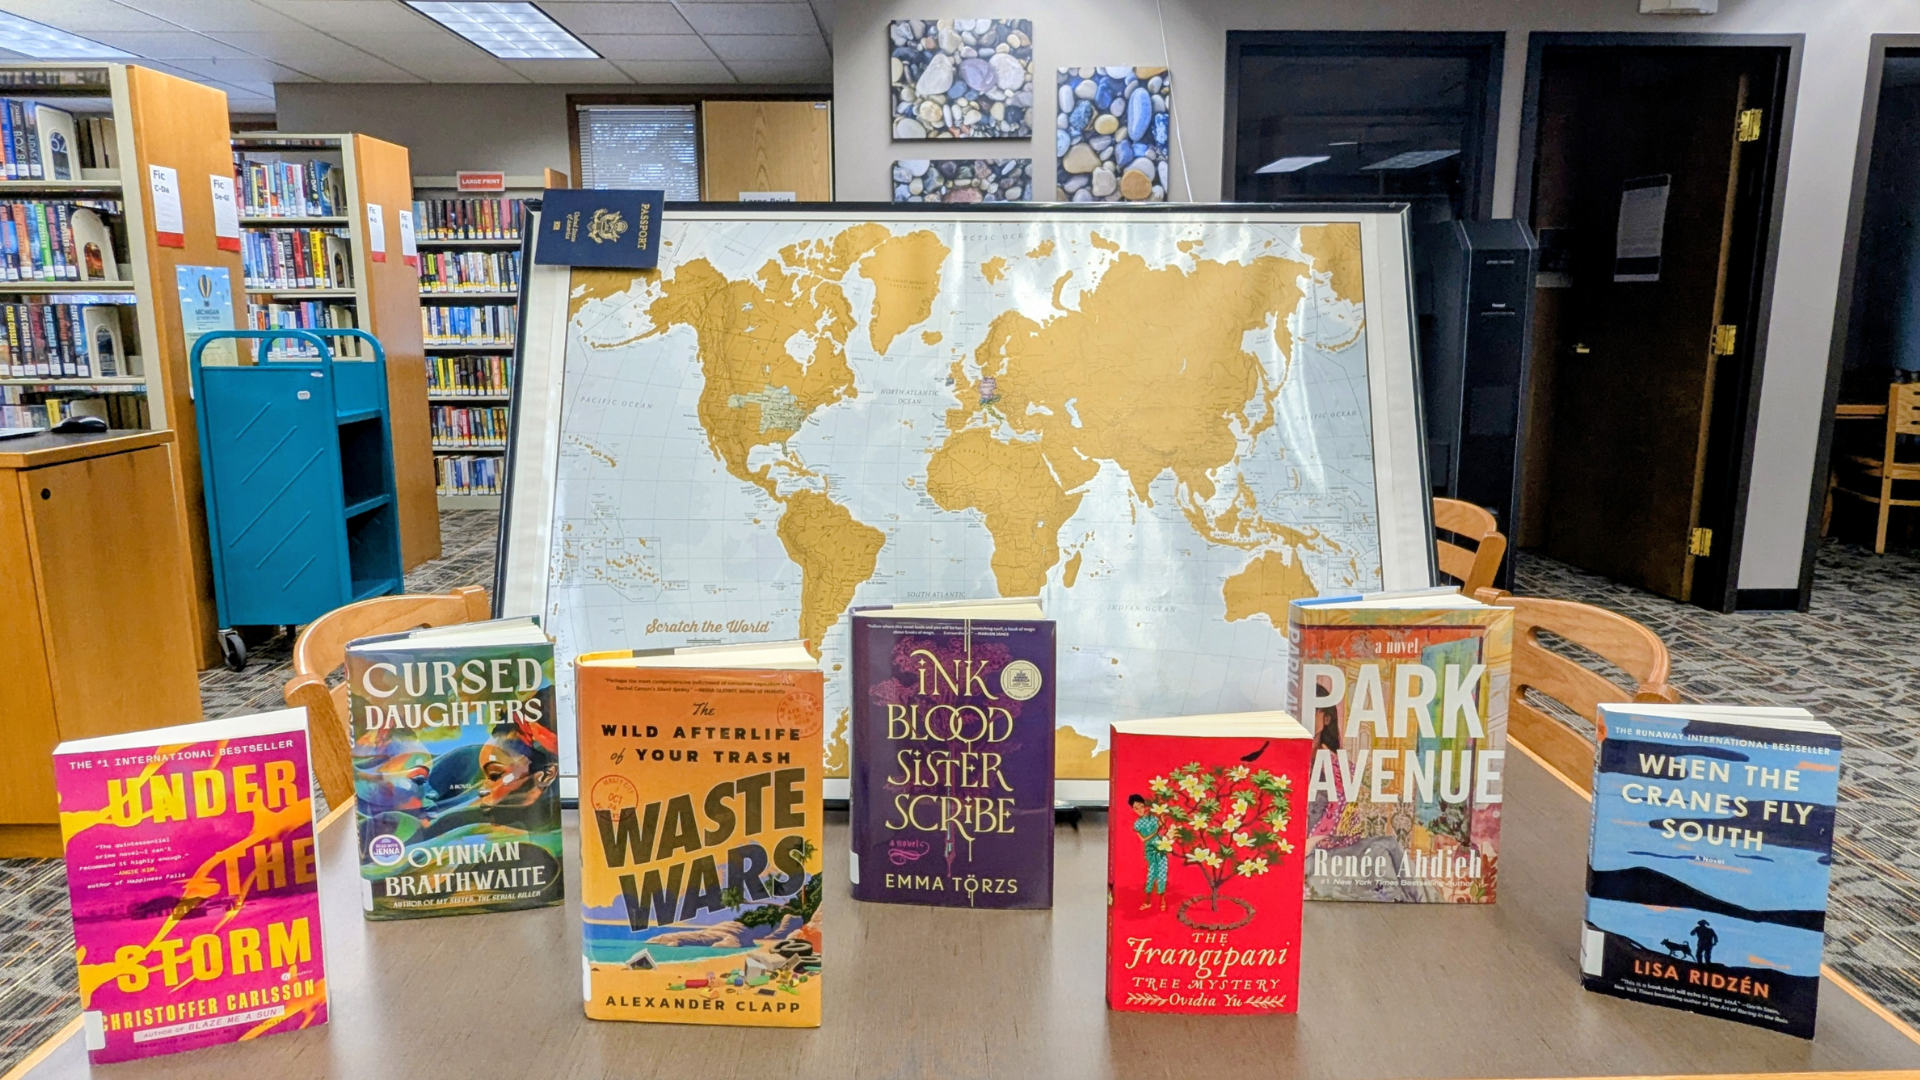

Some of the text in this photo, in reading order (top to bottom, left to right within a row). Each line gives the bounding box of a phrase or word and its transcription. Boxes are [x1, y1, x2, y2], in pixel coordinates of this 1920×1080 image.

[27, 133, 37, 158] JUDAS
[153, 169, 165, 180] Fic
[213, 179, 224, 189] Fic
[154, 184, 170, 193] C-Da
[57, 205, 67, 221] CLIVE
[637, 203, 650, 250] PASSPORT
[6, 305, 15, 322] CLIVE
[20, 305, 29, 322] CLIVE
[70, 304, 80, 321] CLIVE
[581, 396, 653, 409] PACIFIC OCEAN
[1330, 410, 1357, 418] OCEAN
[1145, 605, 1176, 613] OCEAN
[645, 618, 770, 636] Scratch the World
[1374, 638, 1419, 654] a novel
[1287, 627, 1300, 688] PARK
[362, 657, 543, 699] CURSED
[693, 701, 716, 716] The
[1302, 664, 1487, 738] PARK
[364, 698, 543, 731] DAUGHTERS
[887, 704, 1014, 743] BLOOD
[601, 724, 800, 741] WILD AFTERLIFE
[1615, 726, 1831, 756] THE RUNAWAY INTERNATIONAL BESTSELLER
[69, 760, 93, 771] THE
[114, 749, 214, 767] INTERNATIONAL
[219, 739, 294, 756] BESTSELLER
[610, 747, 790, 766] of YOUR TRASH
[887, 749, 1014, 792] SISTER
[1308, 750, 1506, 803] AVENUE
[1638, 753, 1800, 792] WHEN THE
[107, 760, 299, 828] UNDER
[608, 792, 623, 804] OCT
[1621, 783, 1814, 825] CRANES FLY
[594, 767, 807, 869] WASTE
[885, 793, 1016, 842] SCRIBE
[114, 837, 170, 849] quintessential
[897, 839, 919, 847] novel
[1661, 818, 1763, 851] SOUTH
[373, 847, 400, 856] JENNA
[408, 841, 521, 868] OYINKAN
[1703, 856, 1726, 865] Novel
[79, 862, 116, 871] recommend
[130, 857, 155, 866] highly
[216, 837, 317, 896] THE
[1314, 847, 1482, 878] Renée Ahdieh
[87, 881, 112, 889] author
[126, 875, 163, 884] Happiness
[165, 872, 186, 880] Falls
[385, 865, 547, 897] BRAITHWAITE
[618, 834, 807, 933] WARS
[885, 873, 1018, 894] EMMA TÖRZS
[1400, 879, 1445, 887] Bestselling
[393, 900, 423, 909] AUTHOR
[423, 899, 434, 907] OF
[517, 891, 541, 899] KILLER
[1191, 933, 1229, 943] THE
[114, 916, 312, 993] STORM
[1125, 937, 1290, 979] Frangipani
[1132, 976, 1281, 992] TREE MYSTERY
[1634, 960, 1769, 998] LISA RIDZÉN
[1647, 983, 1662, 991] book
[1662, 986, 1676, 994] that
[101, 978, 315, 1032] CHRISTOFFER CARLSSON
[605, 996, 801, 1014] ALEXANDER CLAPP
[1169, 992, 1243, 1007] Ovidia Yu
[143, 1028, 173, 1038] AUTHOR
[188, 1018, 222, 1031] BLAZE
[227, 1015, 241, 1024] ME
[256, 1008, 277, 1018] SUN
